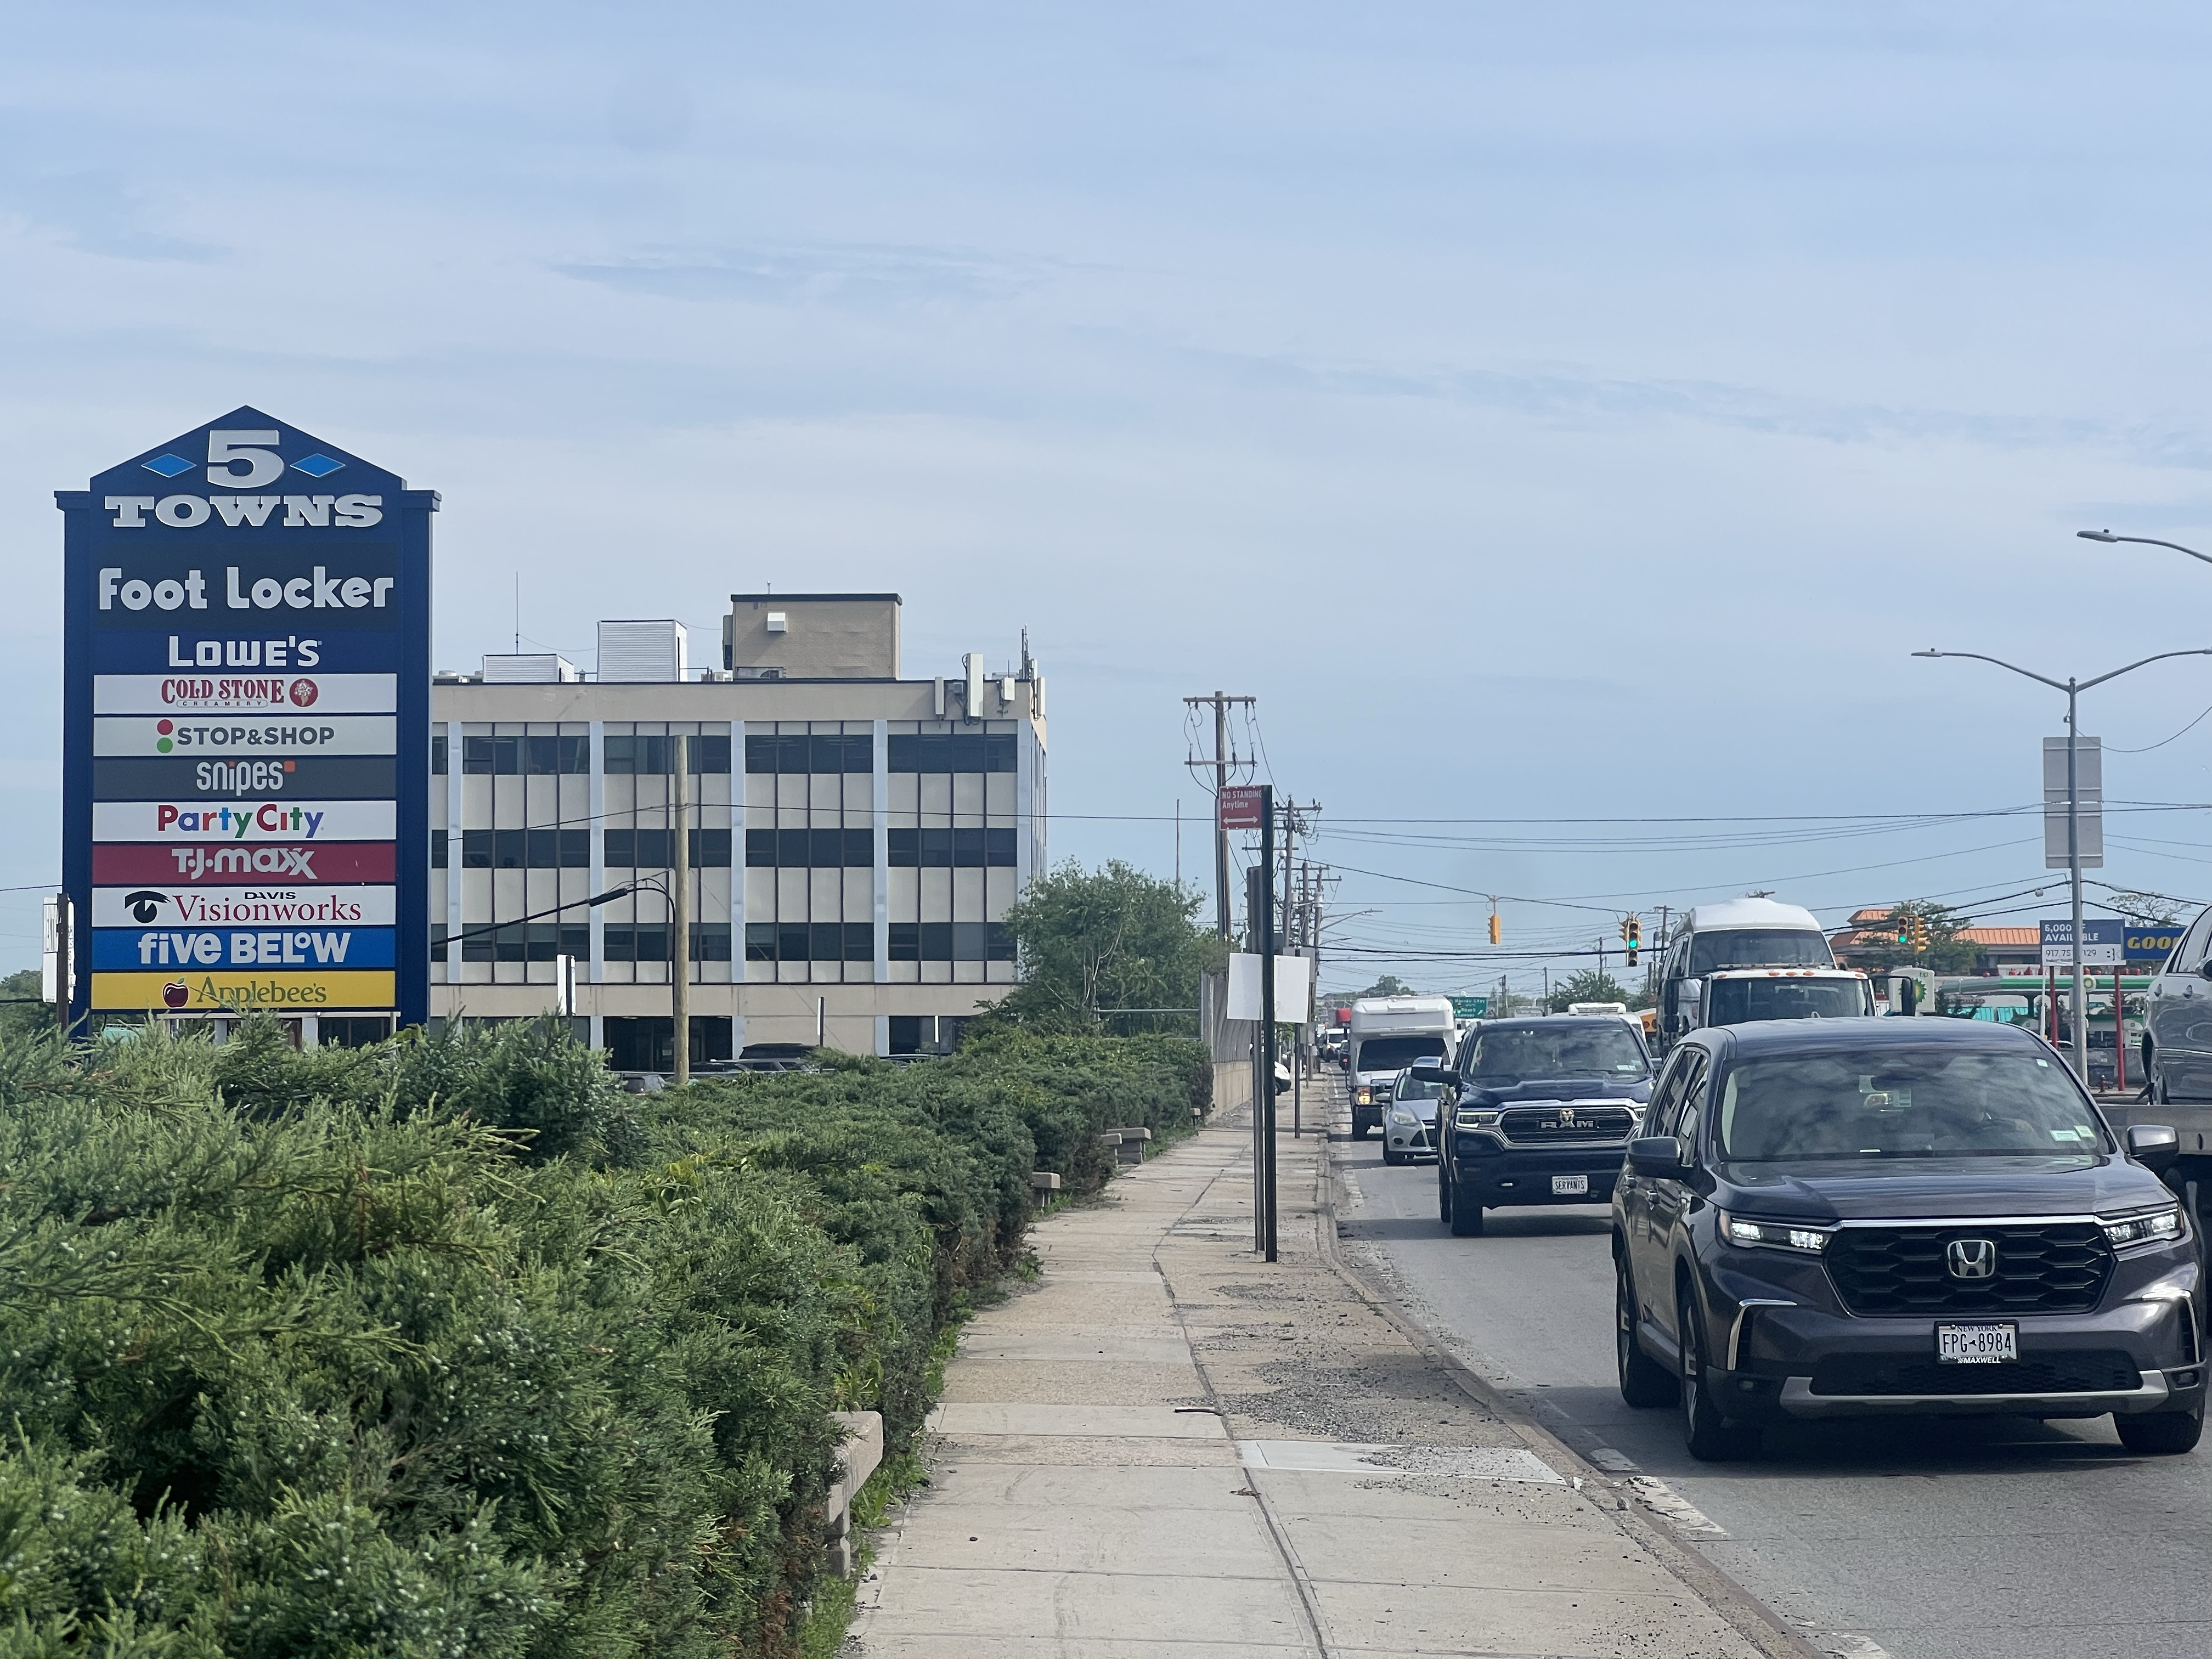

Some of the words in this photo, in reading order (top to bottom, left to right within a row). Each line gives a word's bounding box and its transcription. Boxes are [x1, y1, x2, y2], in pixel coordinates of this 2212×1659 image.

[207, 430, 284, 488] 5
[105, 494, 383, 528] TOWNS
[99, 568, 207, 611] Foot
[227, 566, 394, 609] Locker
[169, 635, 320, 667] LOWE'S
[161, 679, 213, 704] COLD
[218, 679, 284, 703] STONE
[177, 727, 335, 746] STOP&SHOP
[1222, 800, 1249, 810] Anytime
[172, 894, 362, 922] Visionworks
[244, 891, 296, 900] DAVIS
[138, 933, 222, 964] five
[230, 933, 351, 964] BELOW
[1541, 1120, 1594, 1128] RAM
